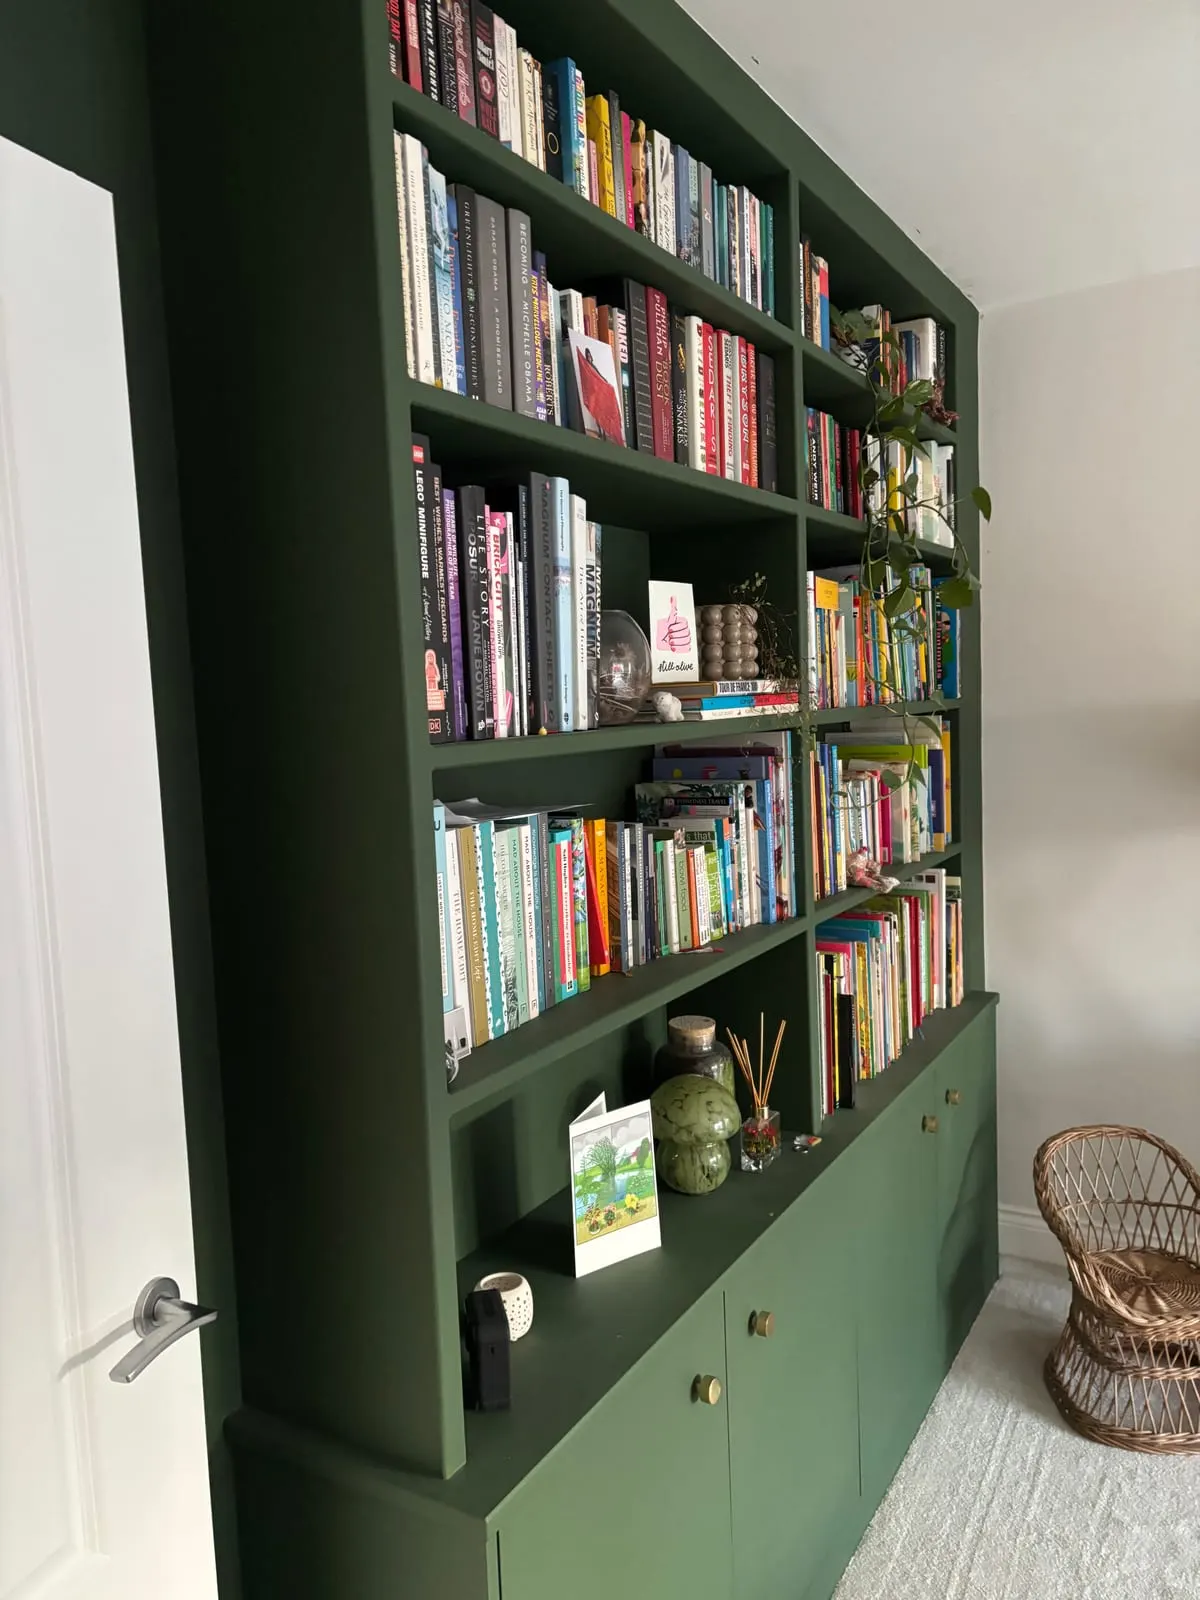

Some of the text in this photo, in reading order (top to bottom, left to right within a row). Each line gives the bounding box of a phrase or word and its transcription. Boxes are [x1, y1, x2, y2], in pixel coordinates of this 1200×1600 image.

[391, 20, 400, 43] DAY
[446, 28, 454, 57] KATE
[389, 43, 397, 75] SIMON
[428, 48, 438, 101] HEIGHTS
[464, 202, 475, 285] GREENLIGHTS
[520, 222, 531, 284] BECOMING
[440, 277, 455, 378] JOJO MOYES
[467, 304, 478, 388] McCONAUGHEY
[533, 296, 543, 382] MARVELLOUS MEDICINE
[617, 312, 628, 363] NAKED
[655, 294, 664, 355] PULLMAN
[660, 306, 669, 348] PHILIP
[522, 300, 534, 402] MICHELLE OBAMA
[544, 364, 554, 415] ROBERTS
[656, 360, 664, 399] DUST
[662, 360, 671, 405] BOOK
[708, 335, 716, 453] SEDARIS
[741, 354, 749, 443] BRYSON
[676, 404, 684, 443] SNAKES
[418, 506, 429, 579] MINIFIGURE
[445, 500, 453, 557] PHOTOGRAPHER
[452, 535, 457, 543] OF
[437, 548, 446, 593] WARMEST
[448, 559, 453, 567] OF
[477, 516, 489, 627] LIFE STORY
[493, 533, 503, 612] BRICK CITY
[541, 483, 555, 702] MAGNUM CONTACT SHEETS
[586, 564, 596, 657] MAGNUM
[440, 596, 448, 643] REGARDS
[472, 609, 484, 712] JANE BOWN
[657, 659, 695, 673] still alive
[719, 682, 751, 693] TOUR DE FRANCE
[430, 722, 440, 731] DK
[694, 831, 711, 840] that
[679, 860, 689, 912] bowl food
[455, 918, 464, 953] HOME
[471, 911, 479, 940] HOME
[458, 955, 466, 983] EDIT
[473, 941, 481, 963] EDIT
